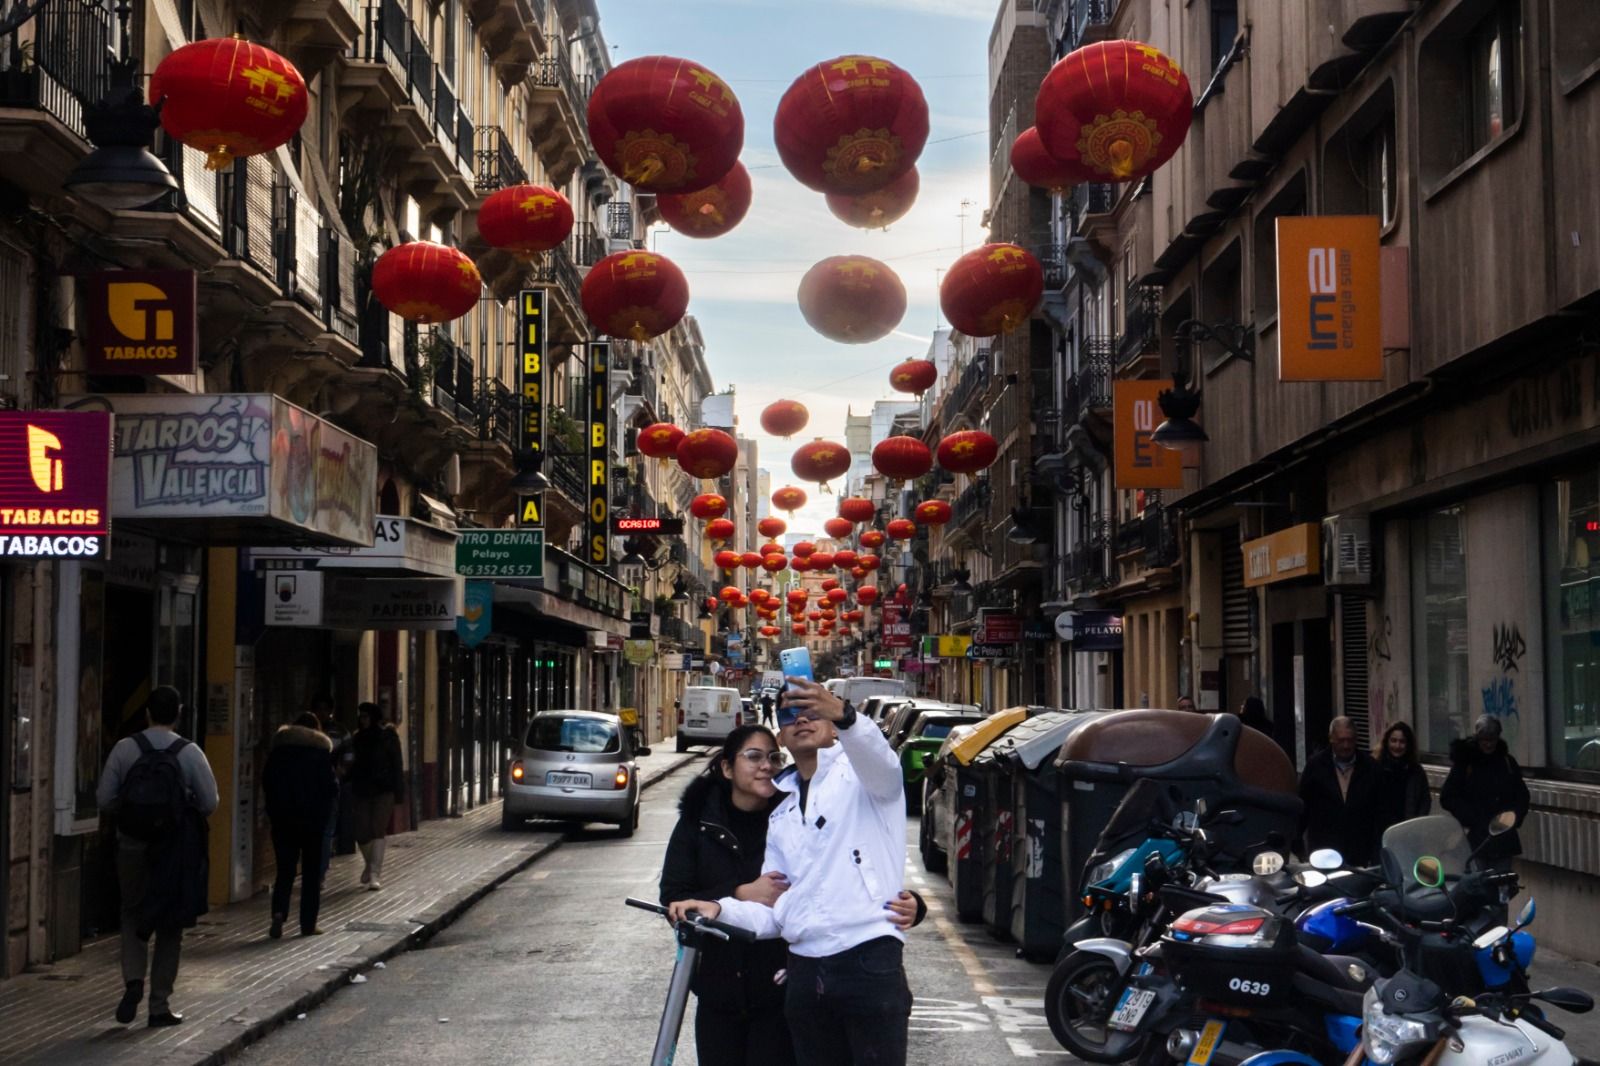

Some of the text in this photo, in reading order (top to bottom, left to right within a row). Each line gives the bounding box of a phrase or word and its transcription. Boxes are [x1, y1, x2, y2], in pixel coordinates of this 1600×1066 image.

[104, 346, 177, 360] TABACOS
[523, 295, 541, 523] LIBREA
[117, 415, 239, 451] TARDOS
[591, 347, 606, 562] LIBROS
[0, 509, 100, 525] TABACOS
[619, 519, 660, 529] OCASION
[0, 536, 99, 556] TABACOS
[457, 532, 541, 545] NTRO DENTAL
[472, 549, 510, 560] Pelayo
[459, 564, 533, 575] 96 352 45 57
[1084, 626, 1122, 635] PELAYO
[1228, 977, 1270, 996] 0639
